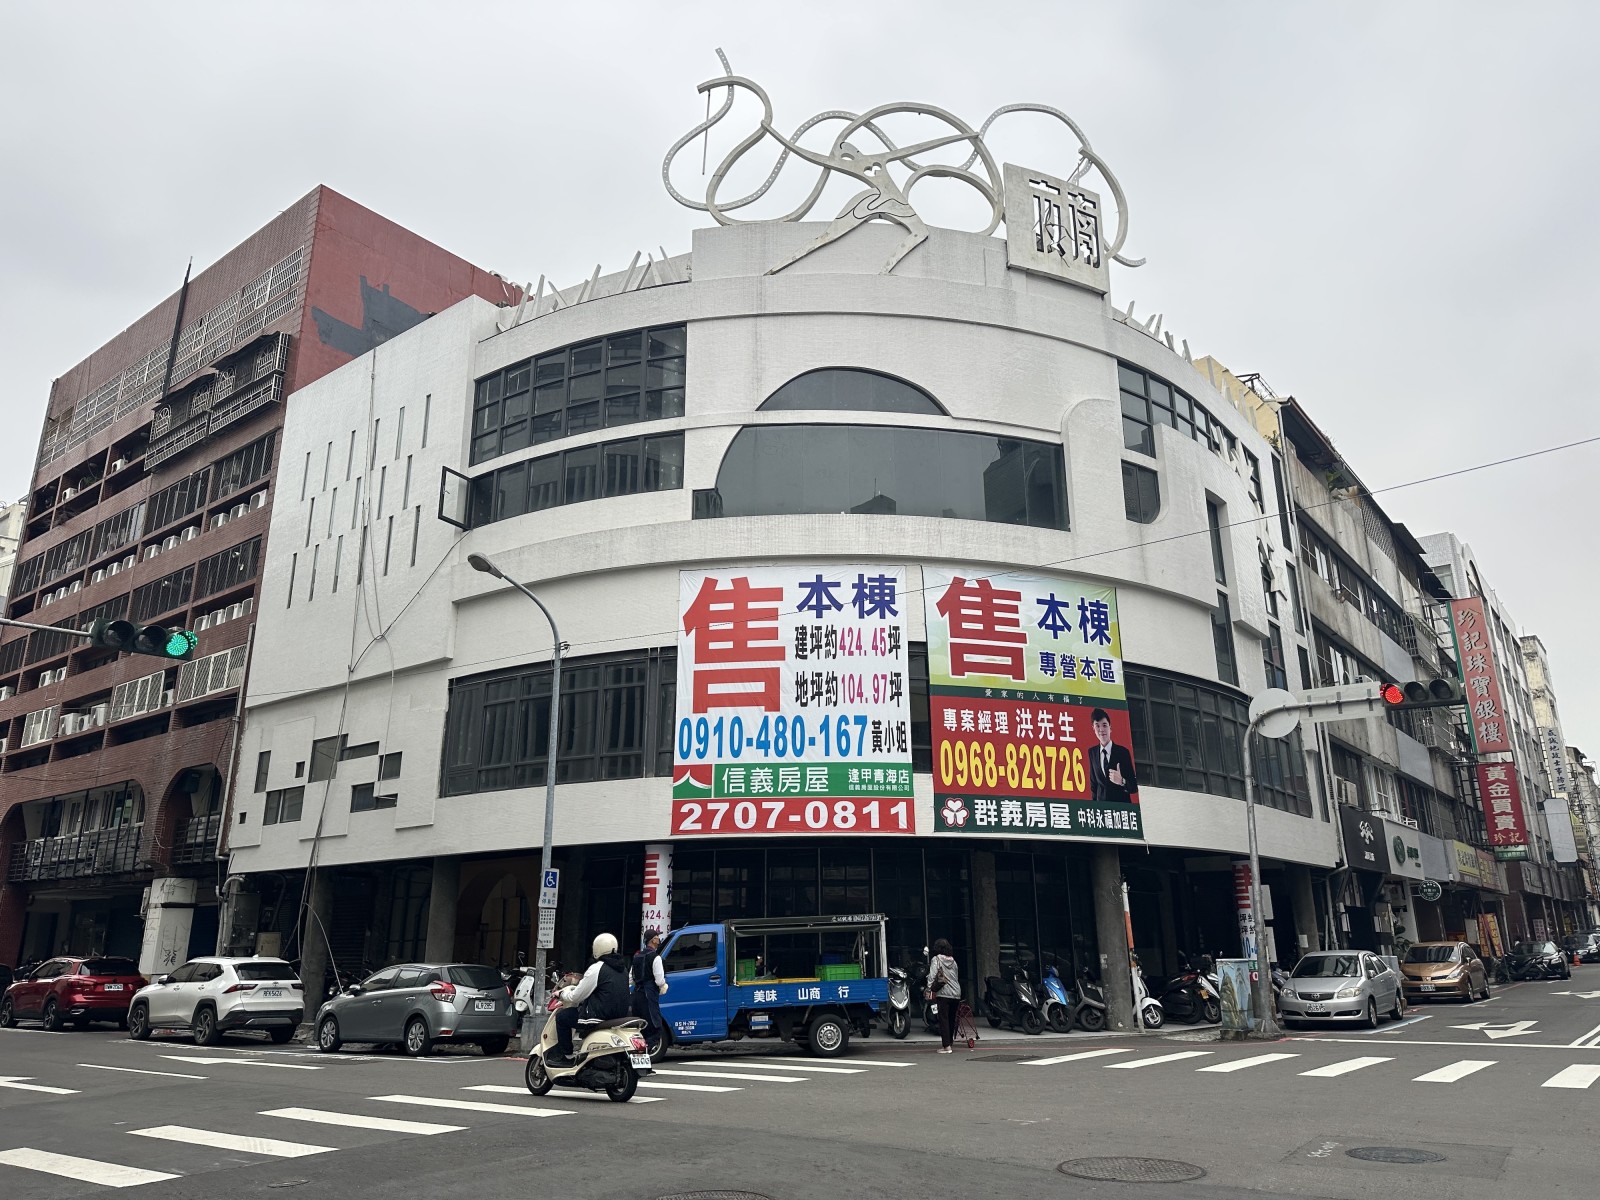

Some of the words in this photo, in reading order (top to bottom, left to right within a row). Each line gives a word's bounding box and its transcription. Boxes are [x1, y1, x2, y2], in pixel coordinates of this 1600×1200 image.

[796, 573, 899, 620] 本棟
[935, 575, 1028, 683] 售
[1036, 592, 1112, 646] 本棟
[683, 576, 786, 714] 售
[1038, 651, 1116, 684] 專營本區
[1457, 608, 1504, 744] 珍記珠寶銀樓
[678, 714, 868, 760] 0910-480-167
[871, 719, 908, 754] 黃小姐
[943, 707, 1010, 735] 專案經理
[1015, 707, 1077, 743] 洪先生
[722, 766, 830, 794] 信義房屋
[848, 768, 910, 784] 逢甲青海店
[940, 739, 1086, 793] 0968-829726
[678, 800, 908, 831] 2707-0811
[974, 799, 1072, 830] 群義房屋
[1485, 765, 1517, 831] 黃金買賣
[1077, 807, 1138, 832] 中科永福加盟店
[1493, 831, 1524, 844] 珍記
[753, 990, 777, 1003] 美味
[798, 987, 820, 1000] 山商
[838, 986, 850, 998] 行
